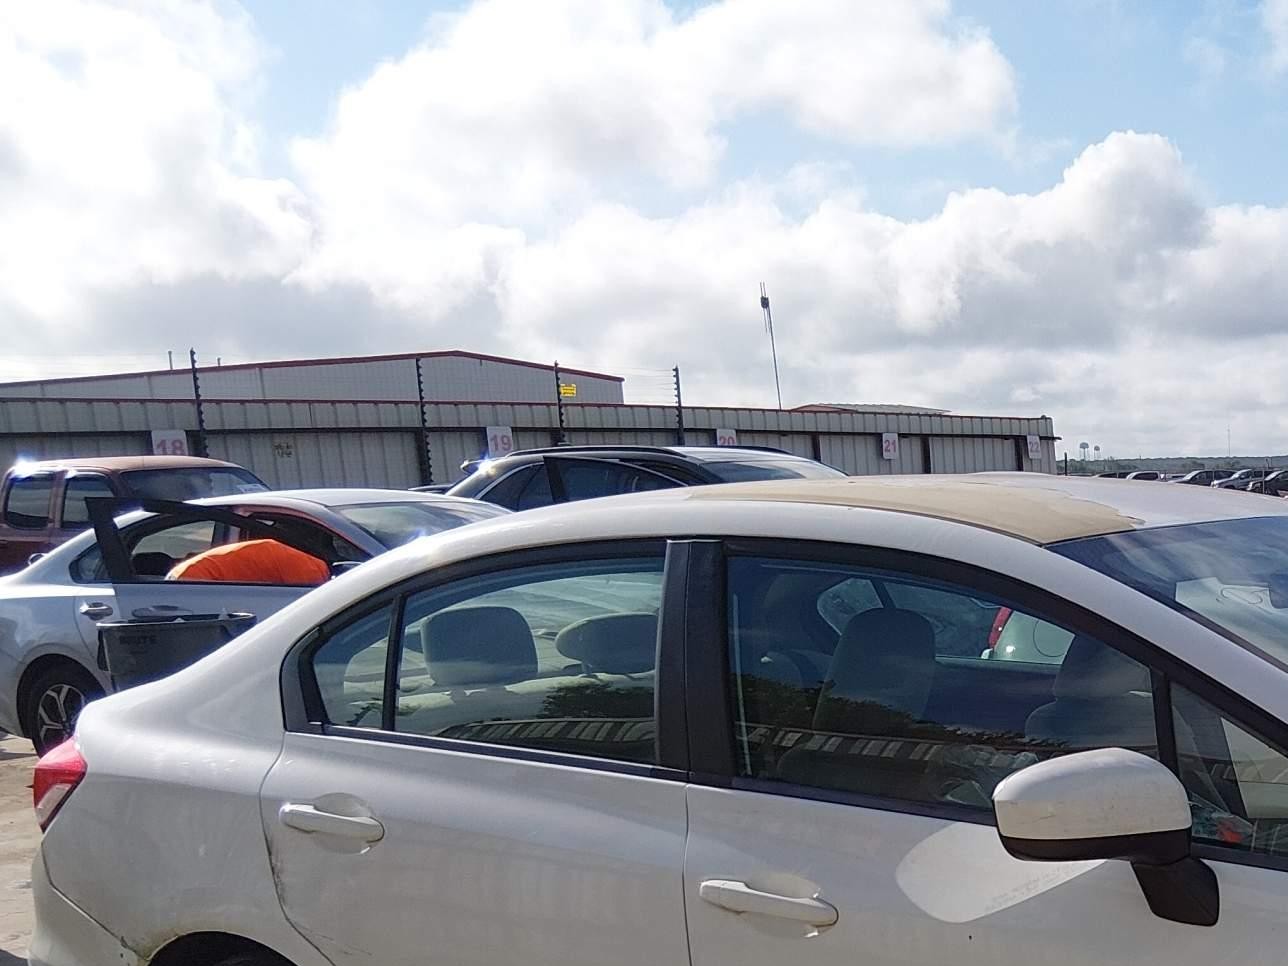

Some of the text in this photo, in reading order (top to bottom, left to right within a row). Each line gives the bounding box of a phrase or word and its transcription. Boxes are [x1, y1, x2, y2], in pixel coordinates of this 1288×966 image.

[156, 439, 185, 456] 18
[490, 434, 512, 451] 19
[719, 436, 737, 446] 20
[884, 439, 897, 453] 21
[1028, 441, 1040, 454] 22
